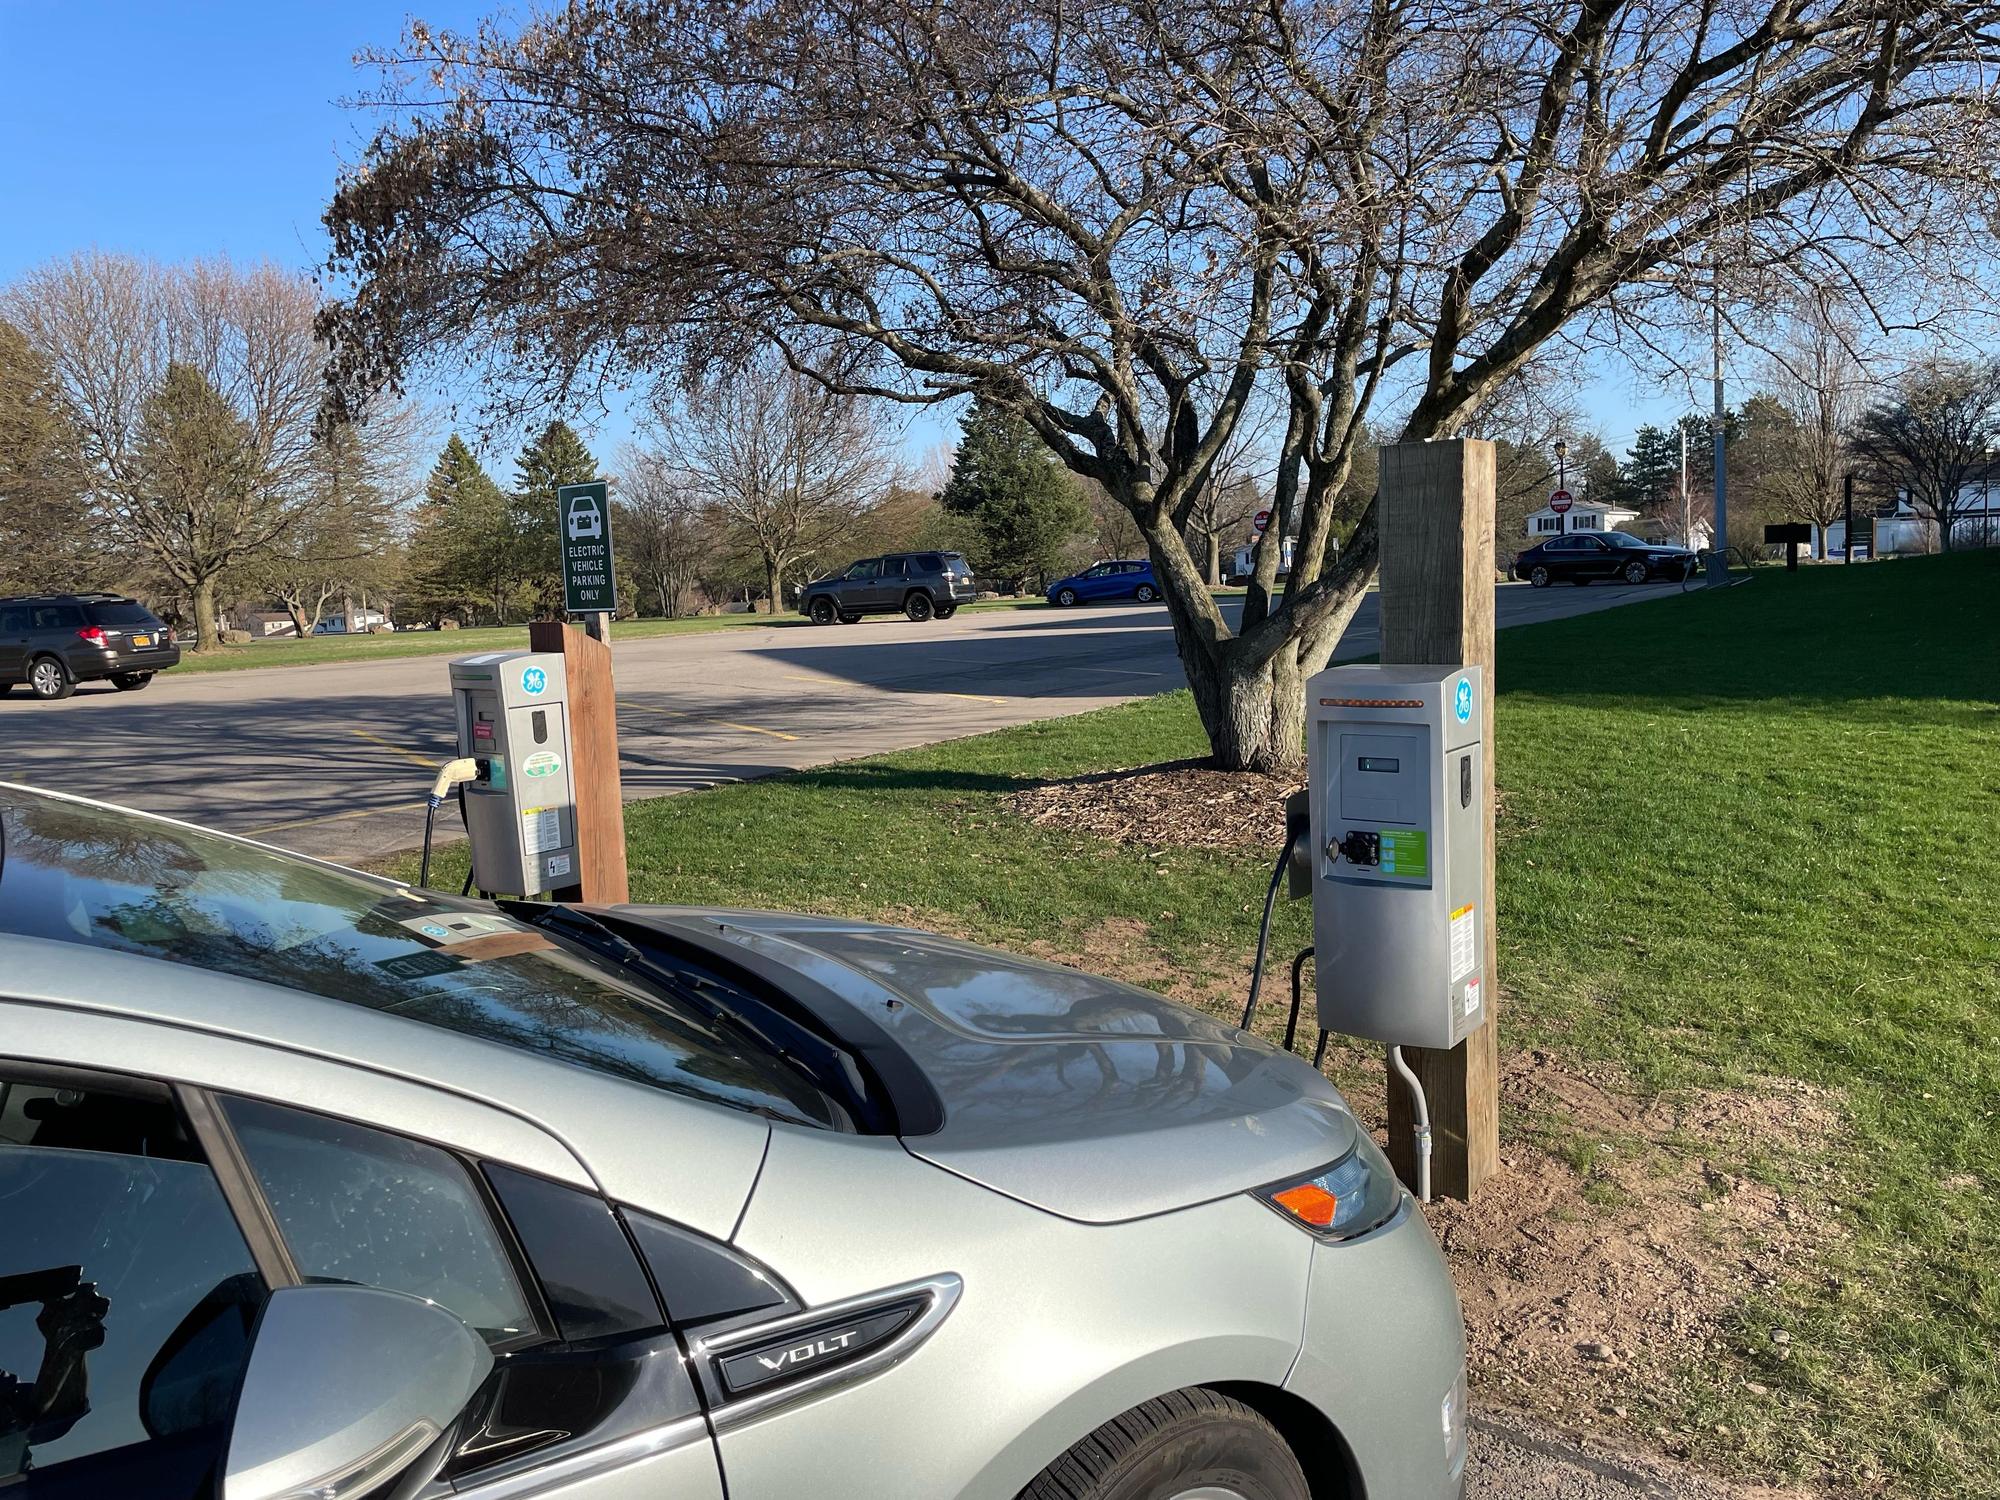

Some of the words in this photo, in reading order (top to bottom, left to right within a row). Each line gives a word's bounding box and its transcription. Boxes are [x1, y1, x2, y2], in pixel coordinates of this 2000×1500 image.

[569, 545, 604, 557] ELECTRIC
[572, 560, 603, 572] VEHICLE
[573, 575, 605, 586] PARKING
[581, 590, 599, 601] ONLY
[756, 1331, 857, 1371] VOLT
